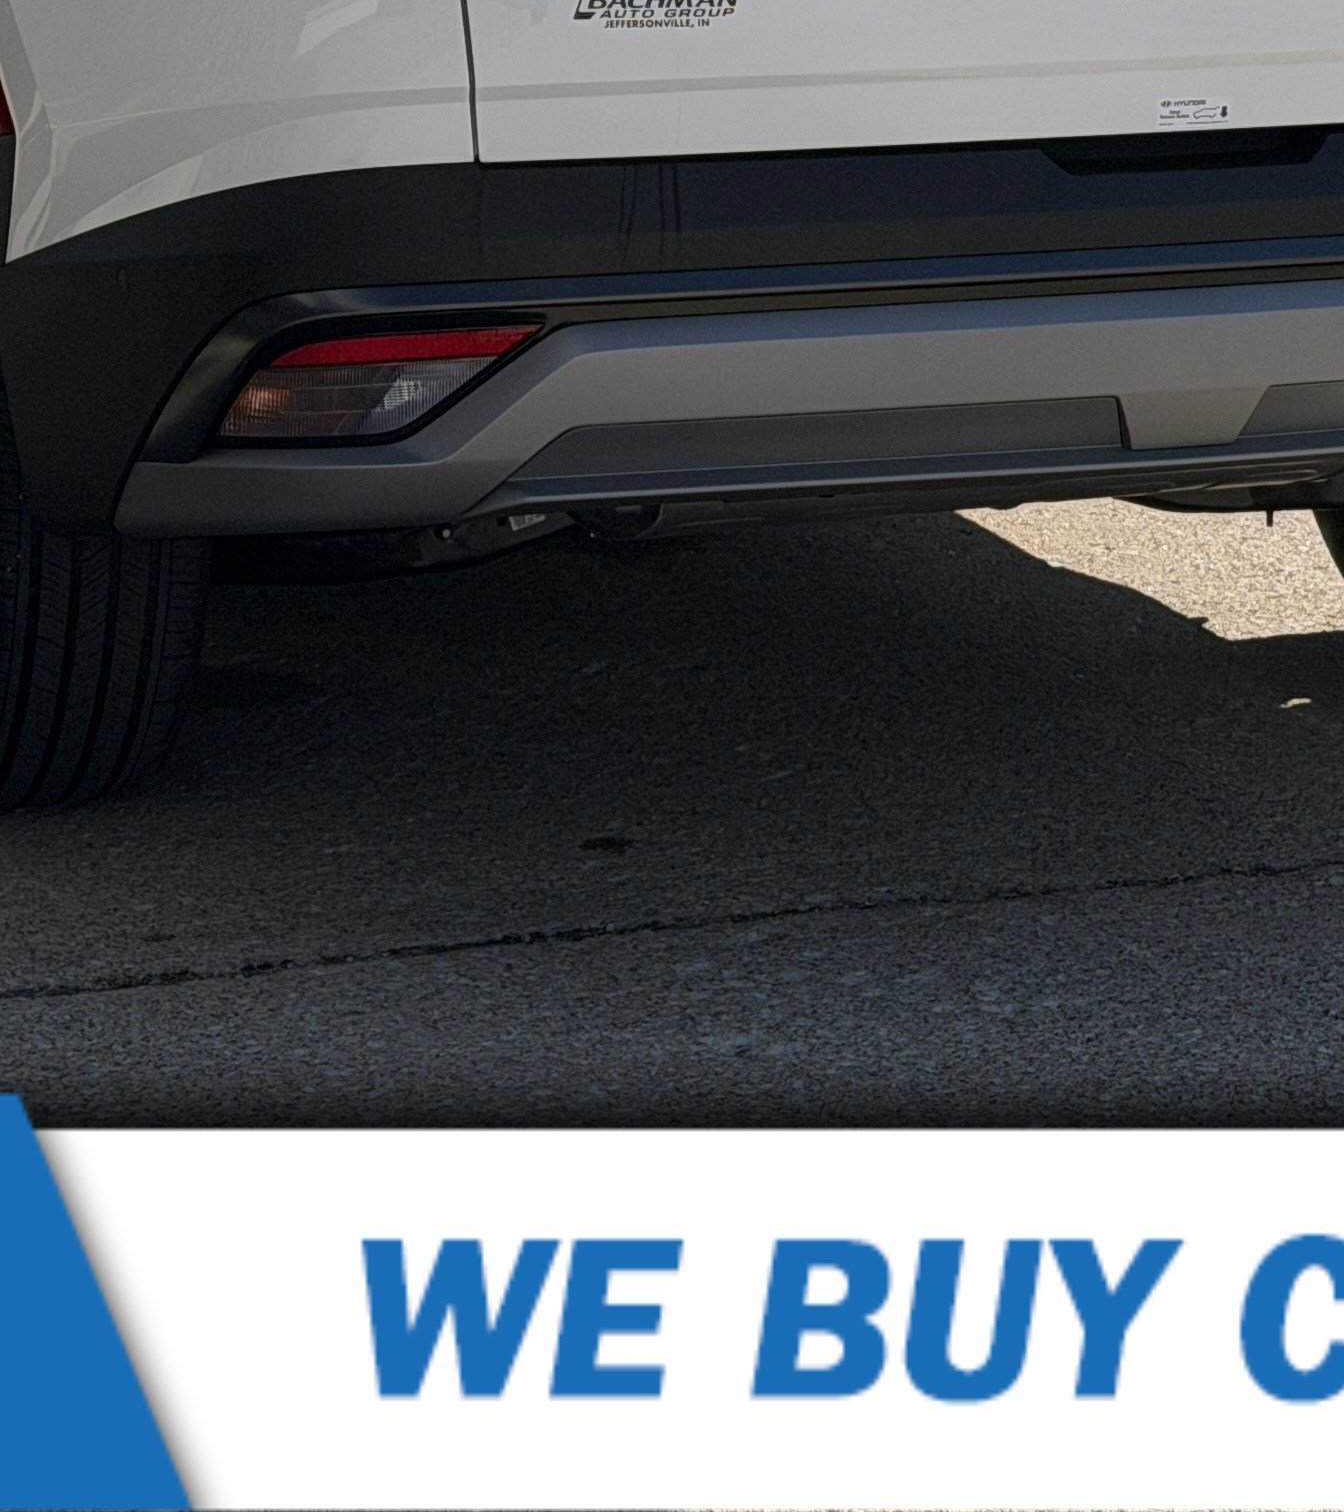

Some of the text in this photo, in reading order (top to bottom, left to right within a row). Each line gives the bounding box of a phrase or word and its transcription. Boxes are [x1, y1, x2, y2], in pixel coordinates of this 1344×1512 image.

[599, 8, 735, 19] AUTO GROUP
[604, 18, 710, 29] JEFFERSONVILLE, IN
